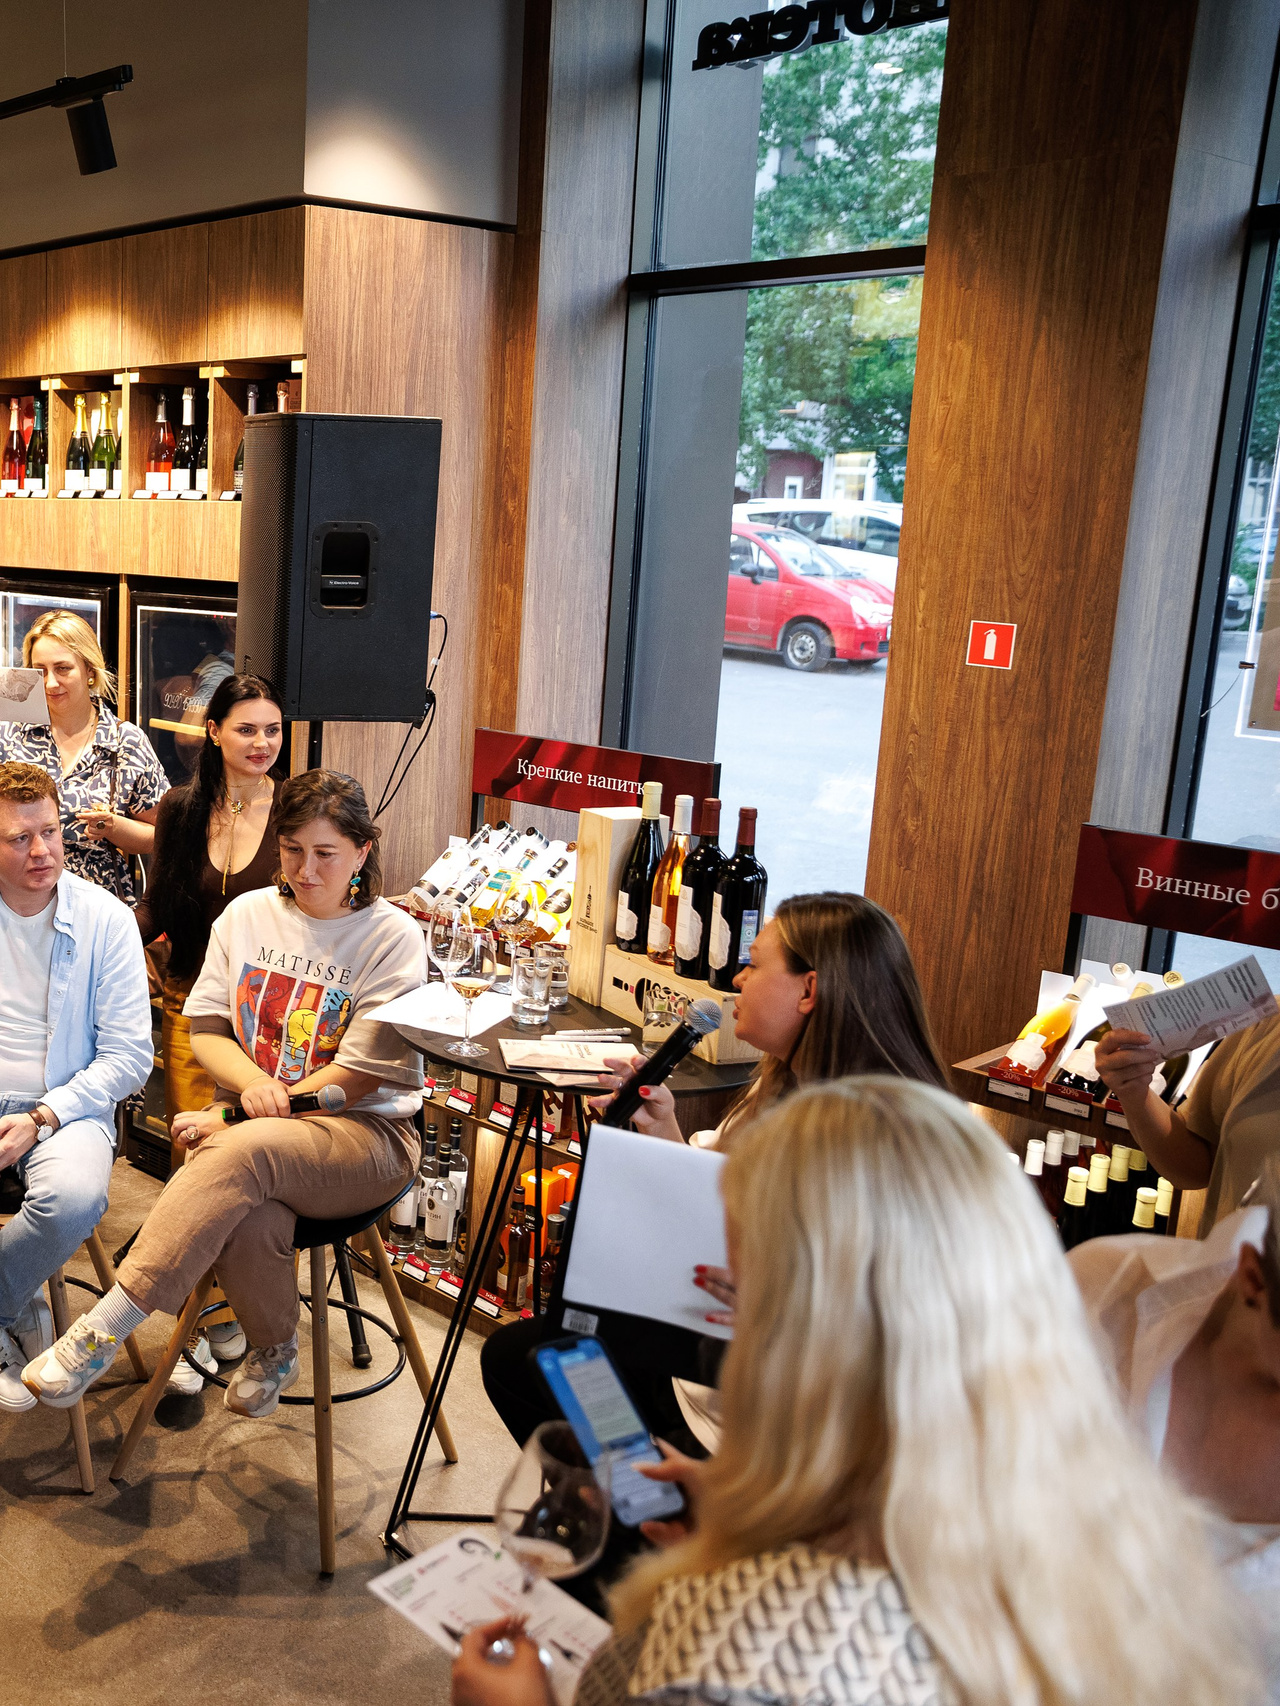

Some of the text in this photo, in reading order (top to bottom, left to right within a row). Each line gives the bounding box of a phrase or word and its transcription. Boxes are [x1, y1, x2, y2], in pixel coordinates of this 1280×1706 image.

[516, 758, 646, 796] Крепкие напитк
[1135, 866, 1251, 905] Винные
[1000, 1070, 1021, 1082] -20%
[1058, 1086, 1080, 1098] -20%
